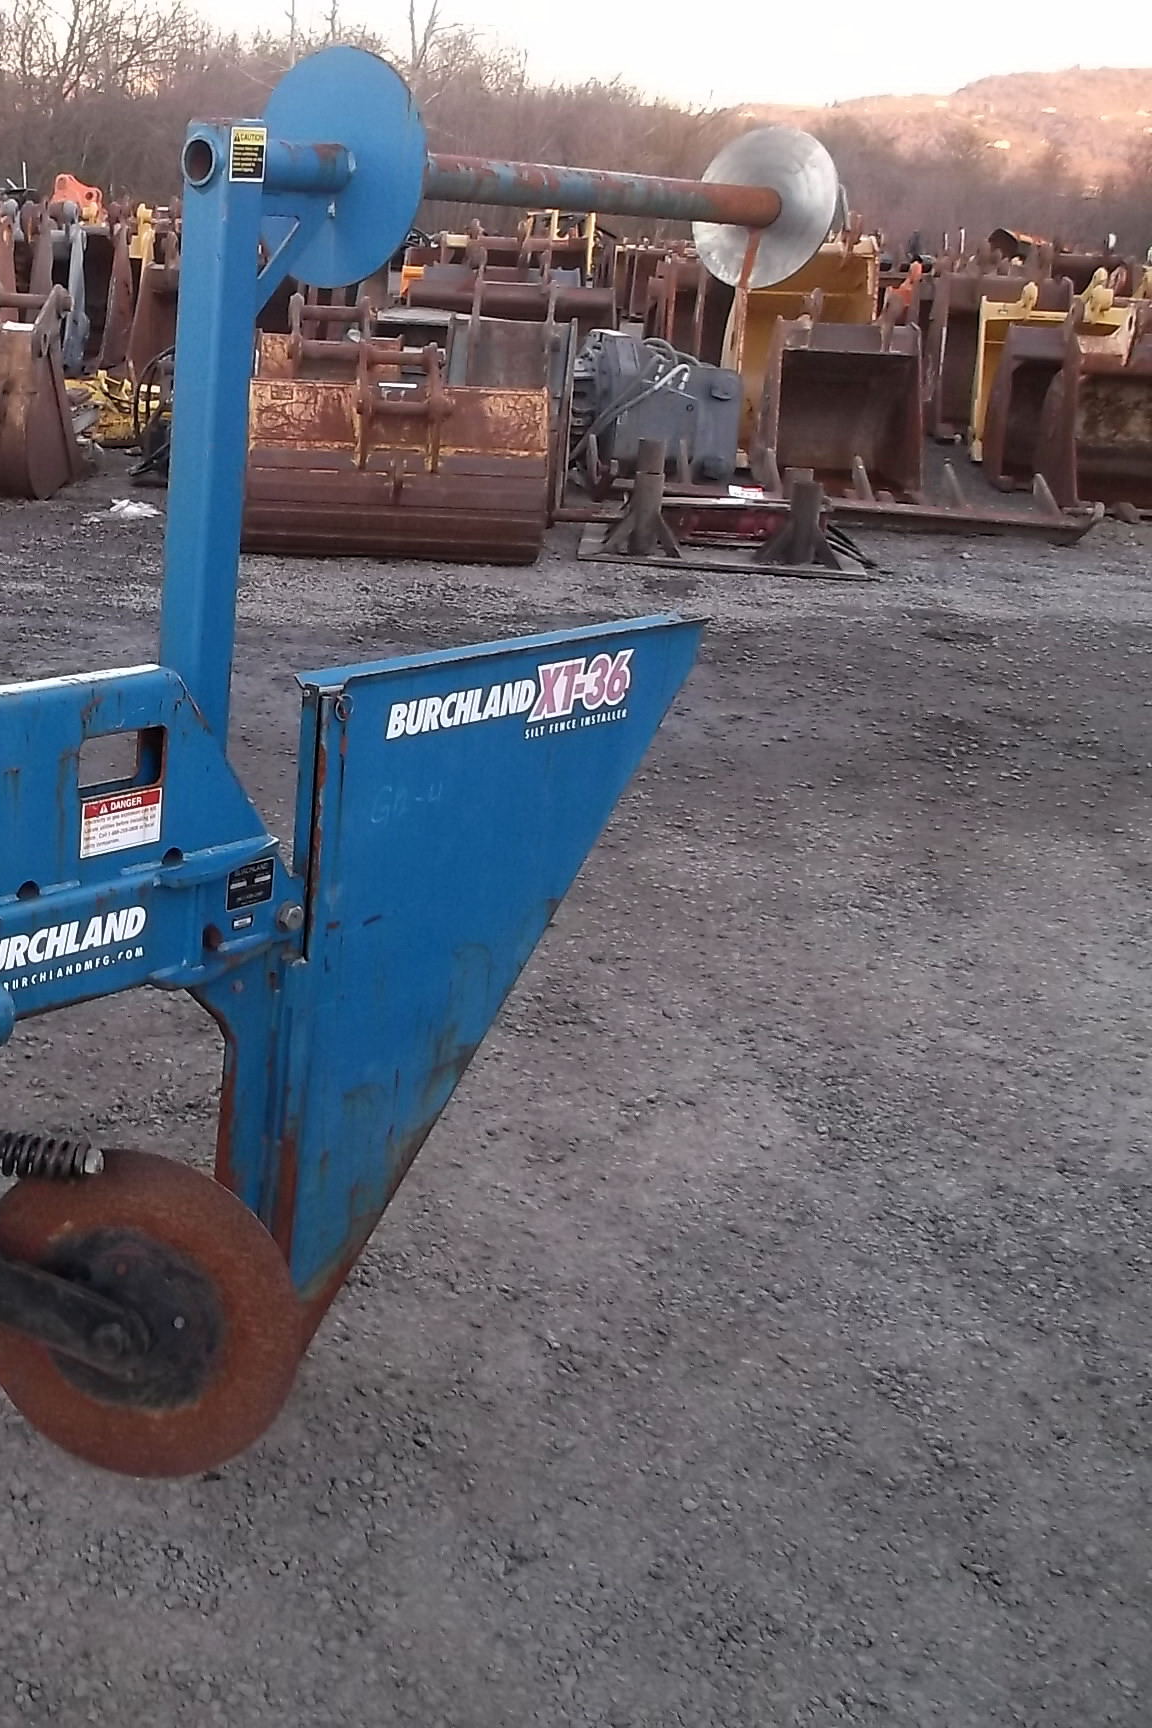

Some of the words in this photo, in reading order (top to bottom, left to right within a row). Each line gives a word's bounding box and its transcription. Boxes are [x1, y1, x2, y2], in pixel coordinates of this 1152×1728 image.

[386, 679, 537, 740] BURCHLAND
[527, 648, 635, 723] XT-36
[524, 726, 546, 740] SILT
[548, 719, 577, 734] FENCE
[580, 708, 628, 727] INSTALLER
[110, 796, 143, 811] DANGER
